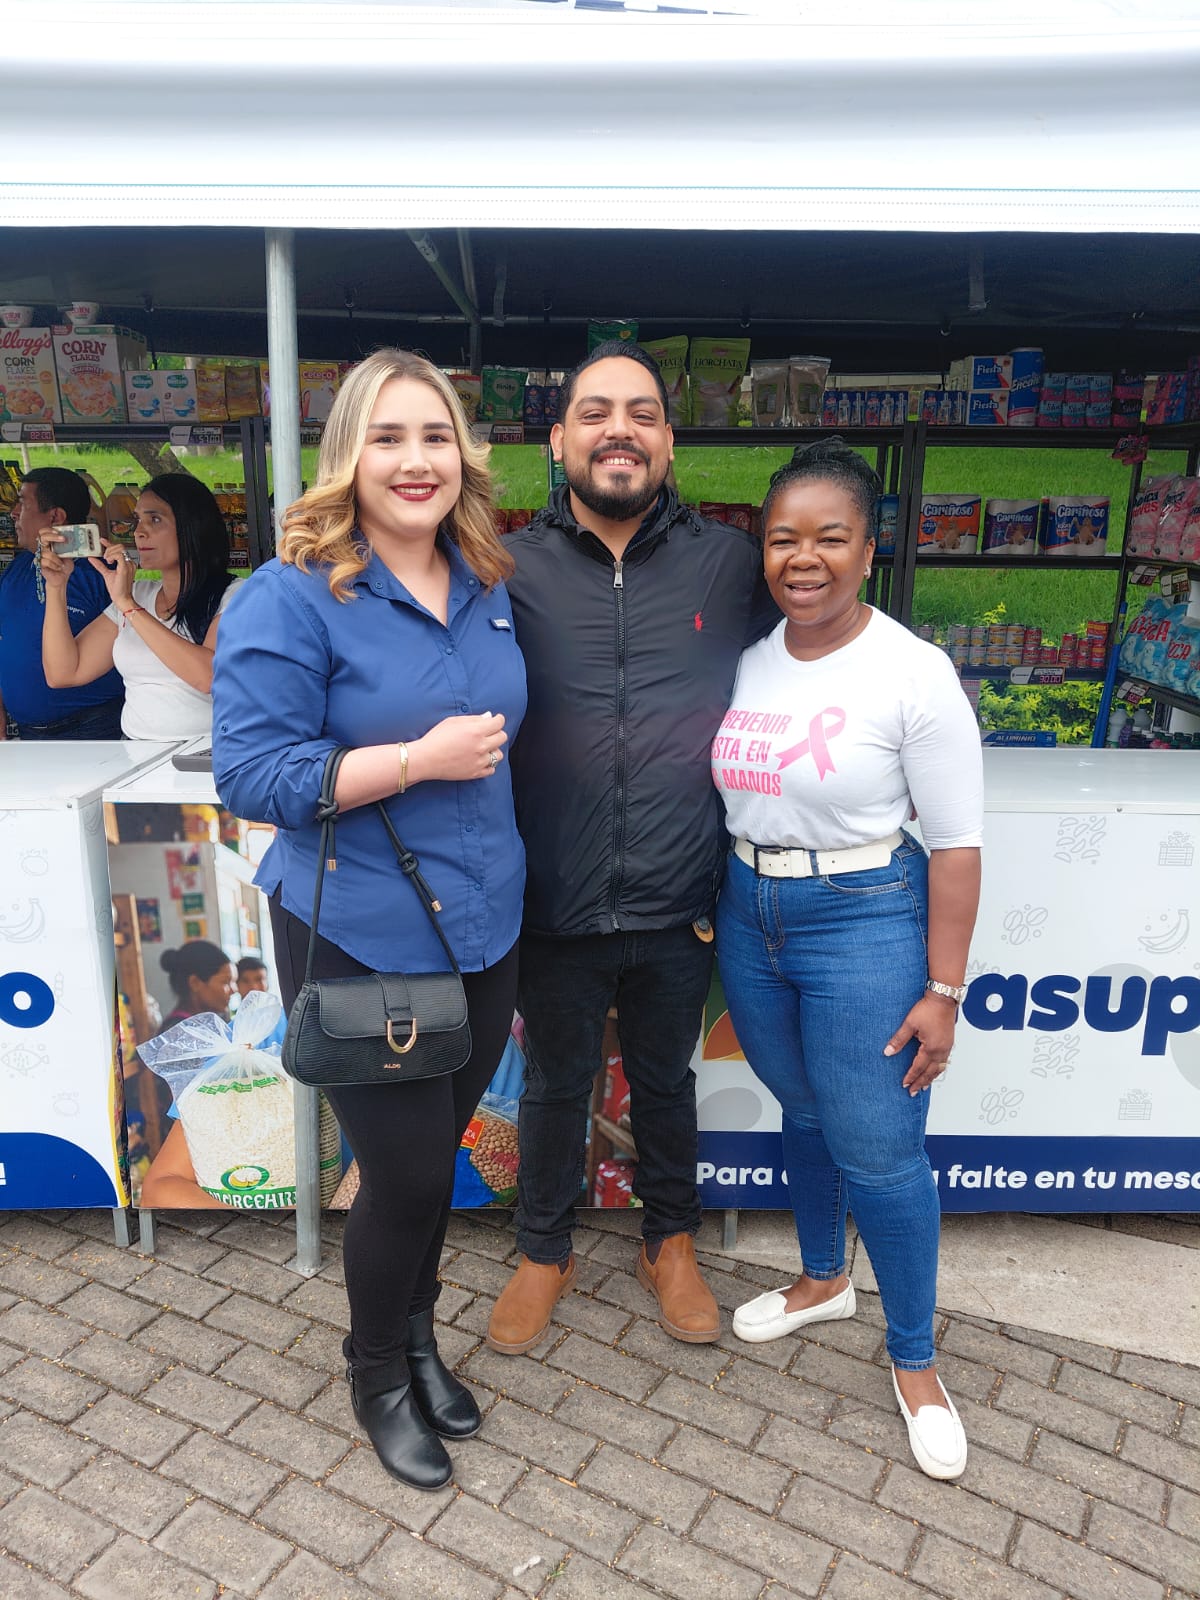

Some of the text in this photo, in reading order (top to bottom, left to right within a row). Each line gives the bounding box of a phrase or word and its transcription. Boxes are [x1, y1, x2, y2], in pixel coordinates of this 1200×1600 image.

[0, 329, 52, 356] llogg's
[62, 340, 107, 356] CORN
[4, 356, 35, 367] CORN
[70, 355, 100, 363] FLAKES
[976, 364, 1002, 376] Fiesta
[973, 400, 998, 411] Fiesta
[923, 503, 973, 517] Cariñoso
[720, 709, 793, 735] REVENIR
[746, 739, 772, 763] EN
[722, 768, 782, 796] MANOS
[956, 973, 1200, 1056] asup
[696, 1162, 773, 1185] Para
[947, 1164, 1027, 1189] falte
[1034, 1171, 1075, 1189] en
[1082, 1167, 1116, 1189] tu
